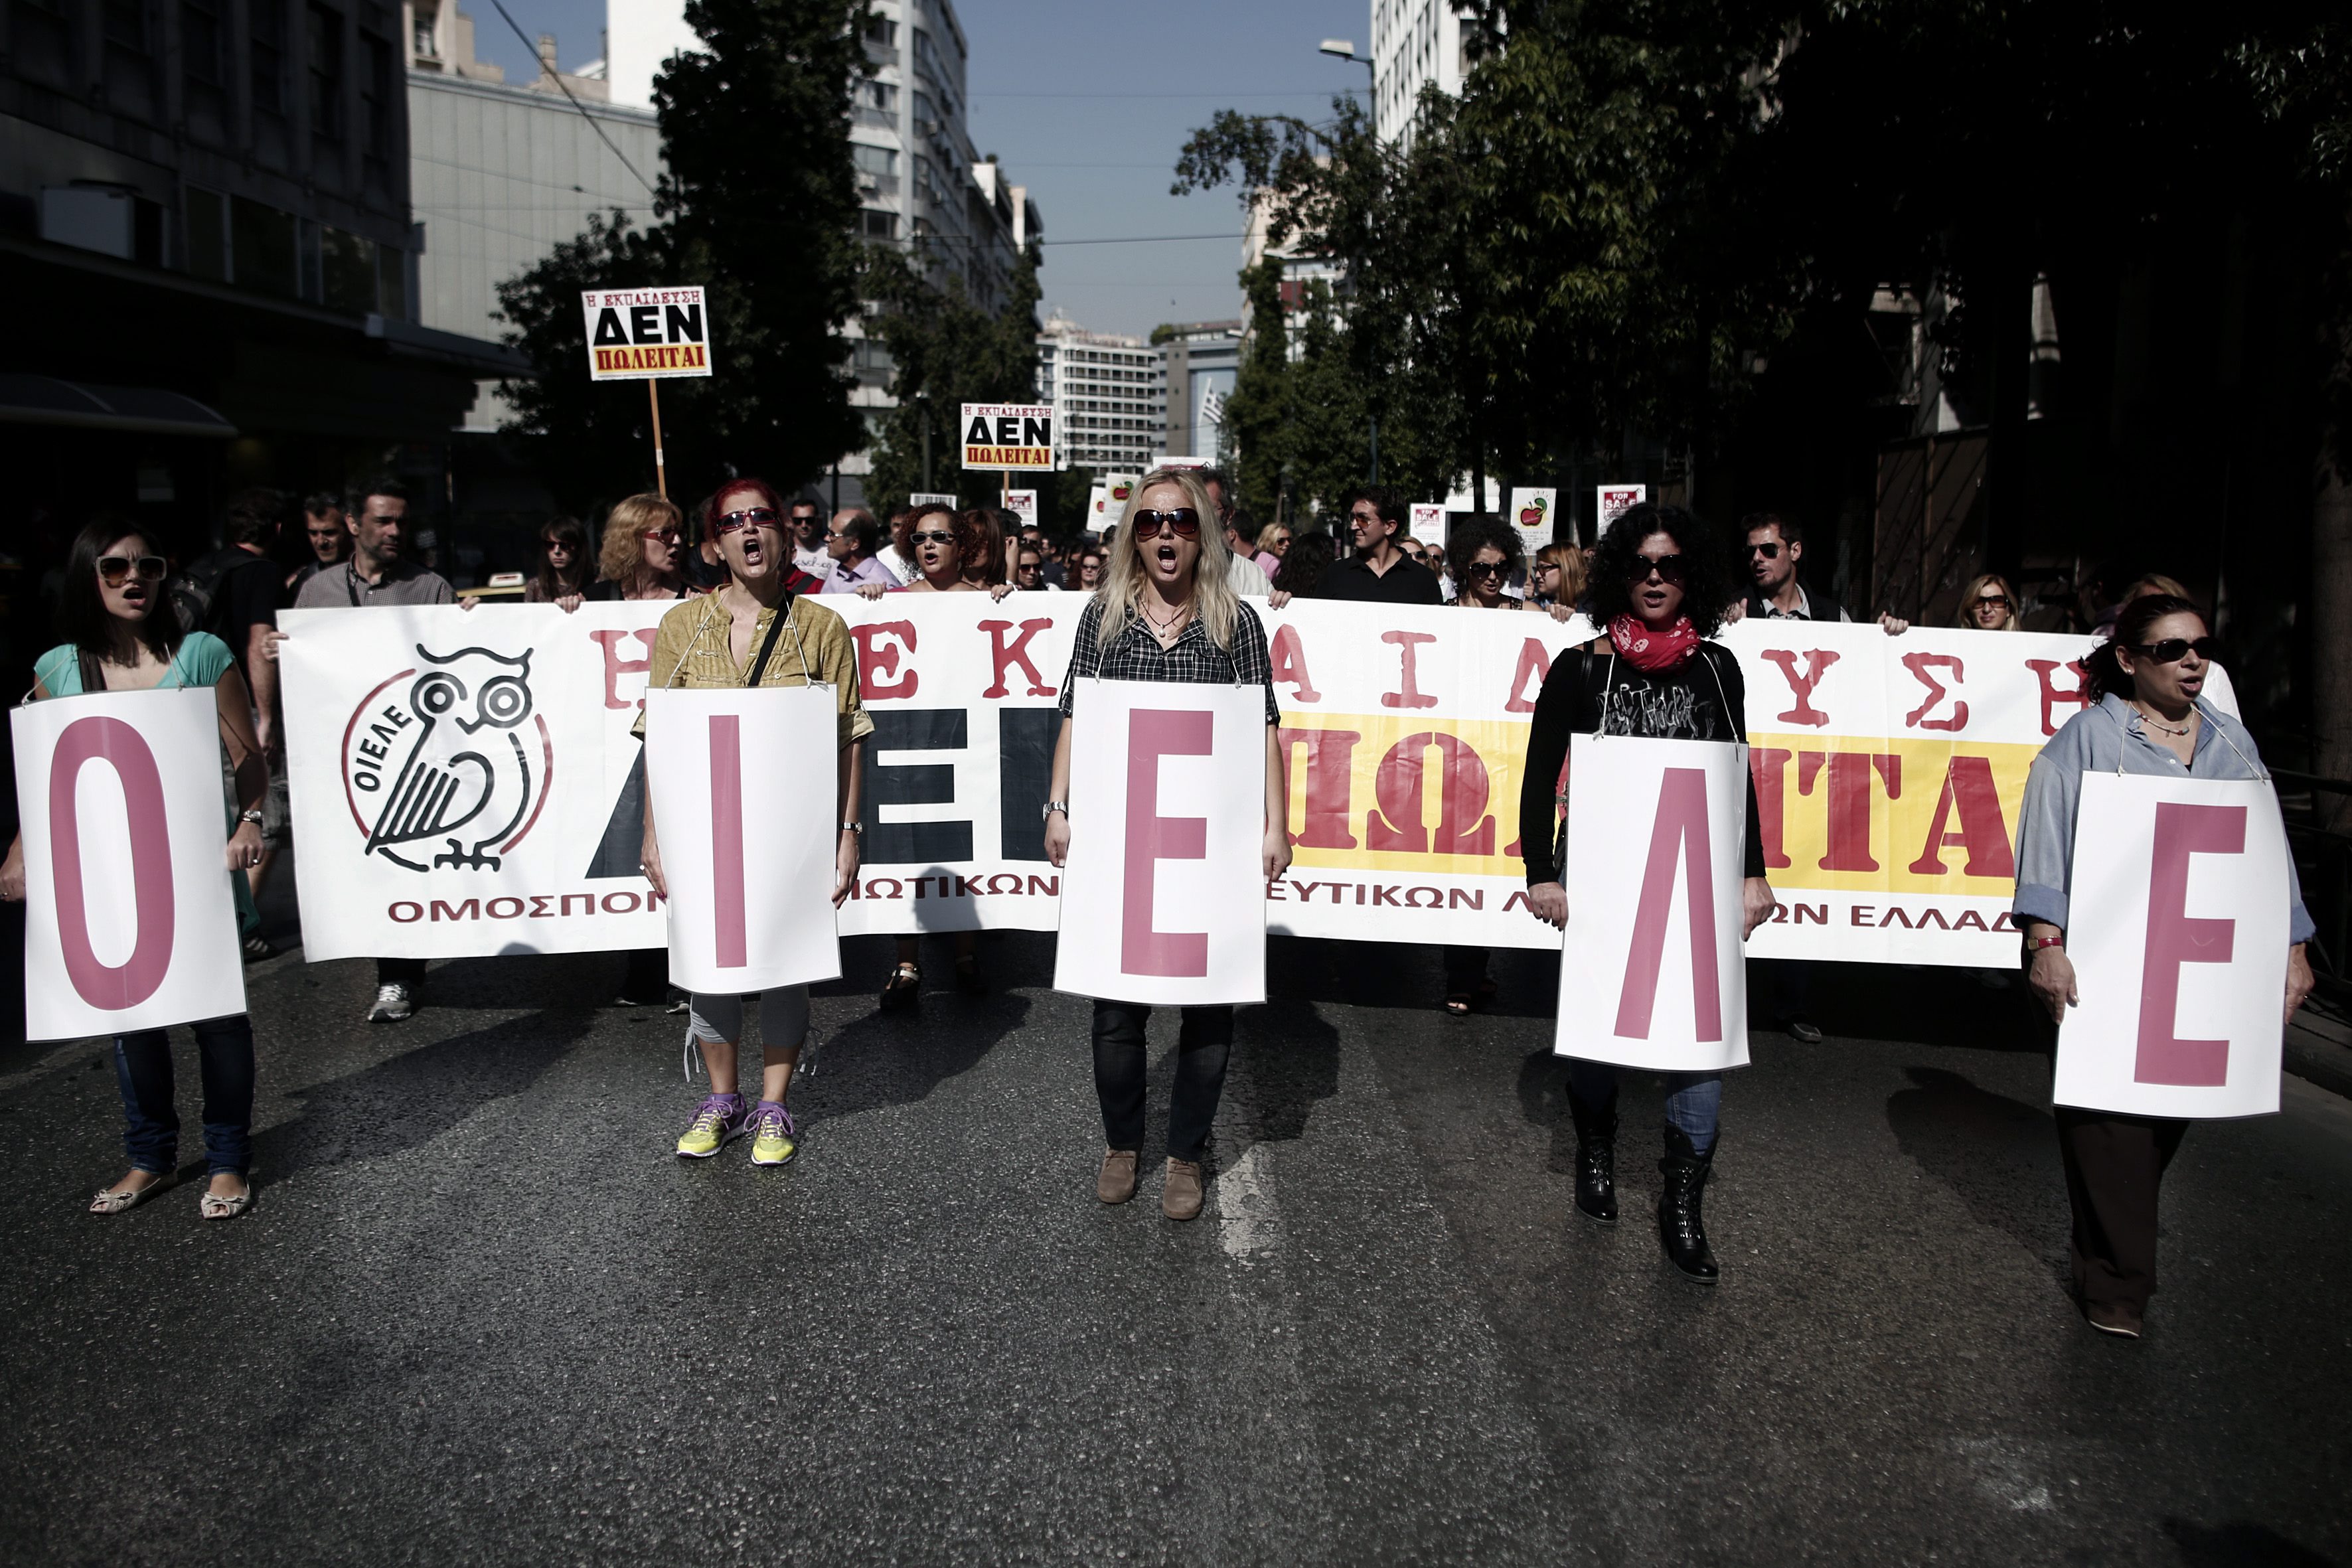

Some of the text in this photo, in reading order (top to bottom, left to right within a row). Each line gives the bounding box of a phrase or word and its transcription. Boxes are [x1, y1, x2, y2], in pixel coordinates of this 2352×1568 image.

[586, 291, 701, 307] Η ΕΚΠΑΙΔΕΥΣΗ
[593, 304, 704, 346] ΔΕΝ
[596, 346, 705, 370] ΠΩΛΕΙΤΑΙ
[964, 406, 1052, 418] Η ΕΚΠΑΙΔΕΥΣΗ
[965, 416, 1051, 446] ΔΕΝ
[967, 447, 1050, 464] ΠΩΛΕΙΤΑΙ
[354, 705, 414, 793] ΟΙΕΛΕ
[1121, 708, 1214, 978] Ε
[1266, 880, 1484, 911] ΕΥΤΙΚΩΝ
[1851, 905, 2023, 933] ΕΛΛΑΔ
[1614, 767, 1722, 1043] Λ
[2134, 802, 2248, 1087] Ε
